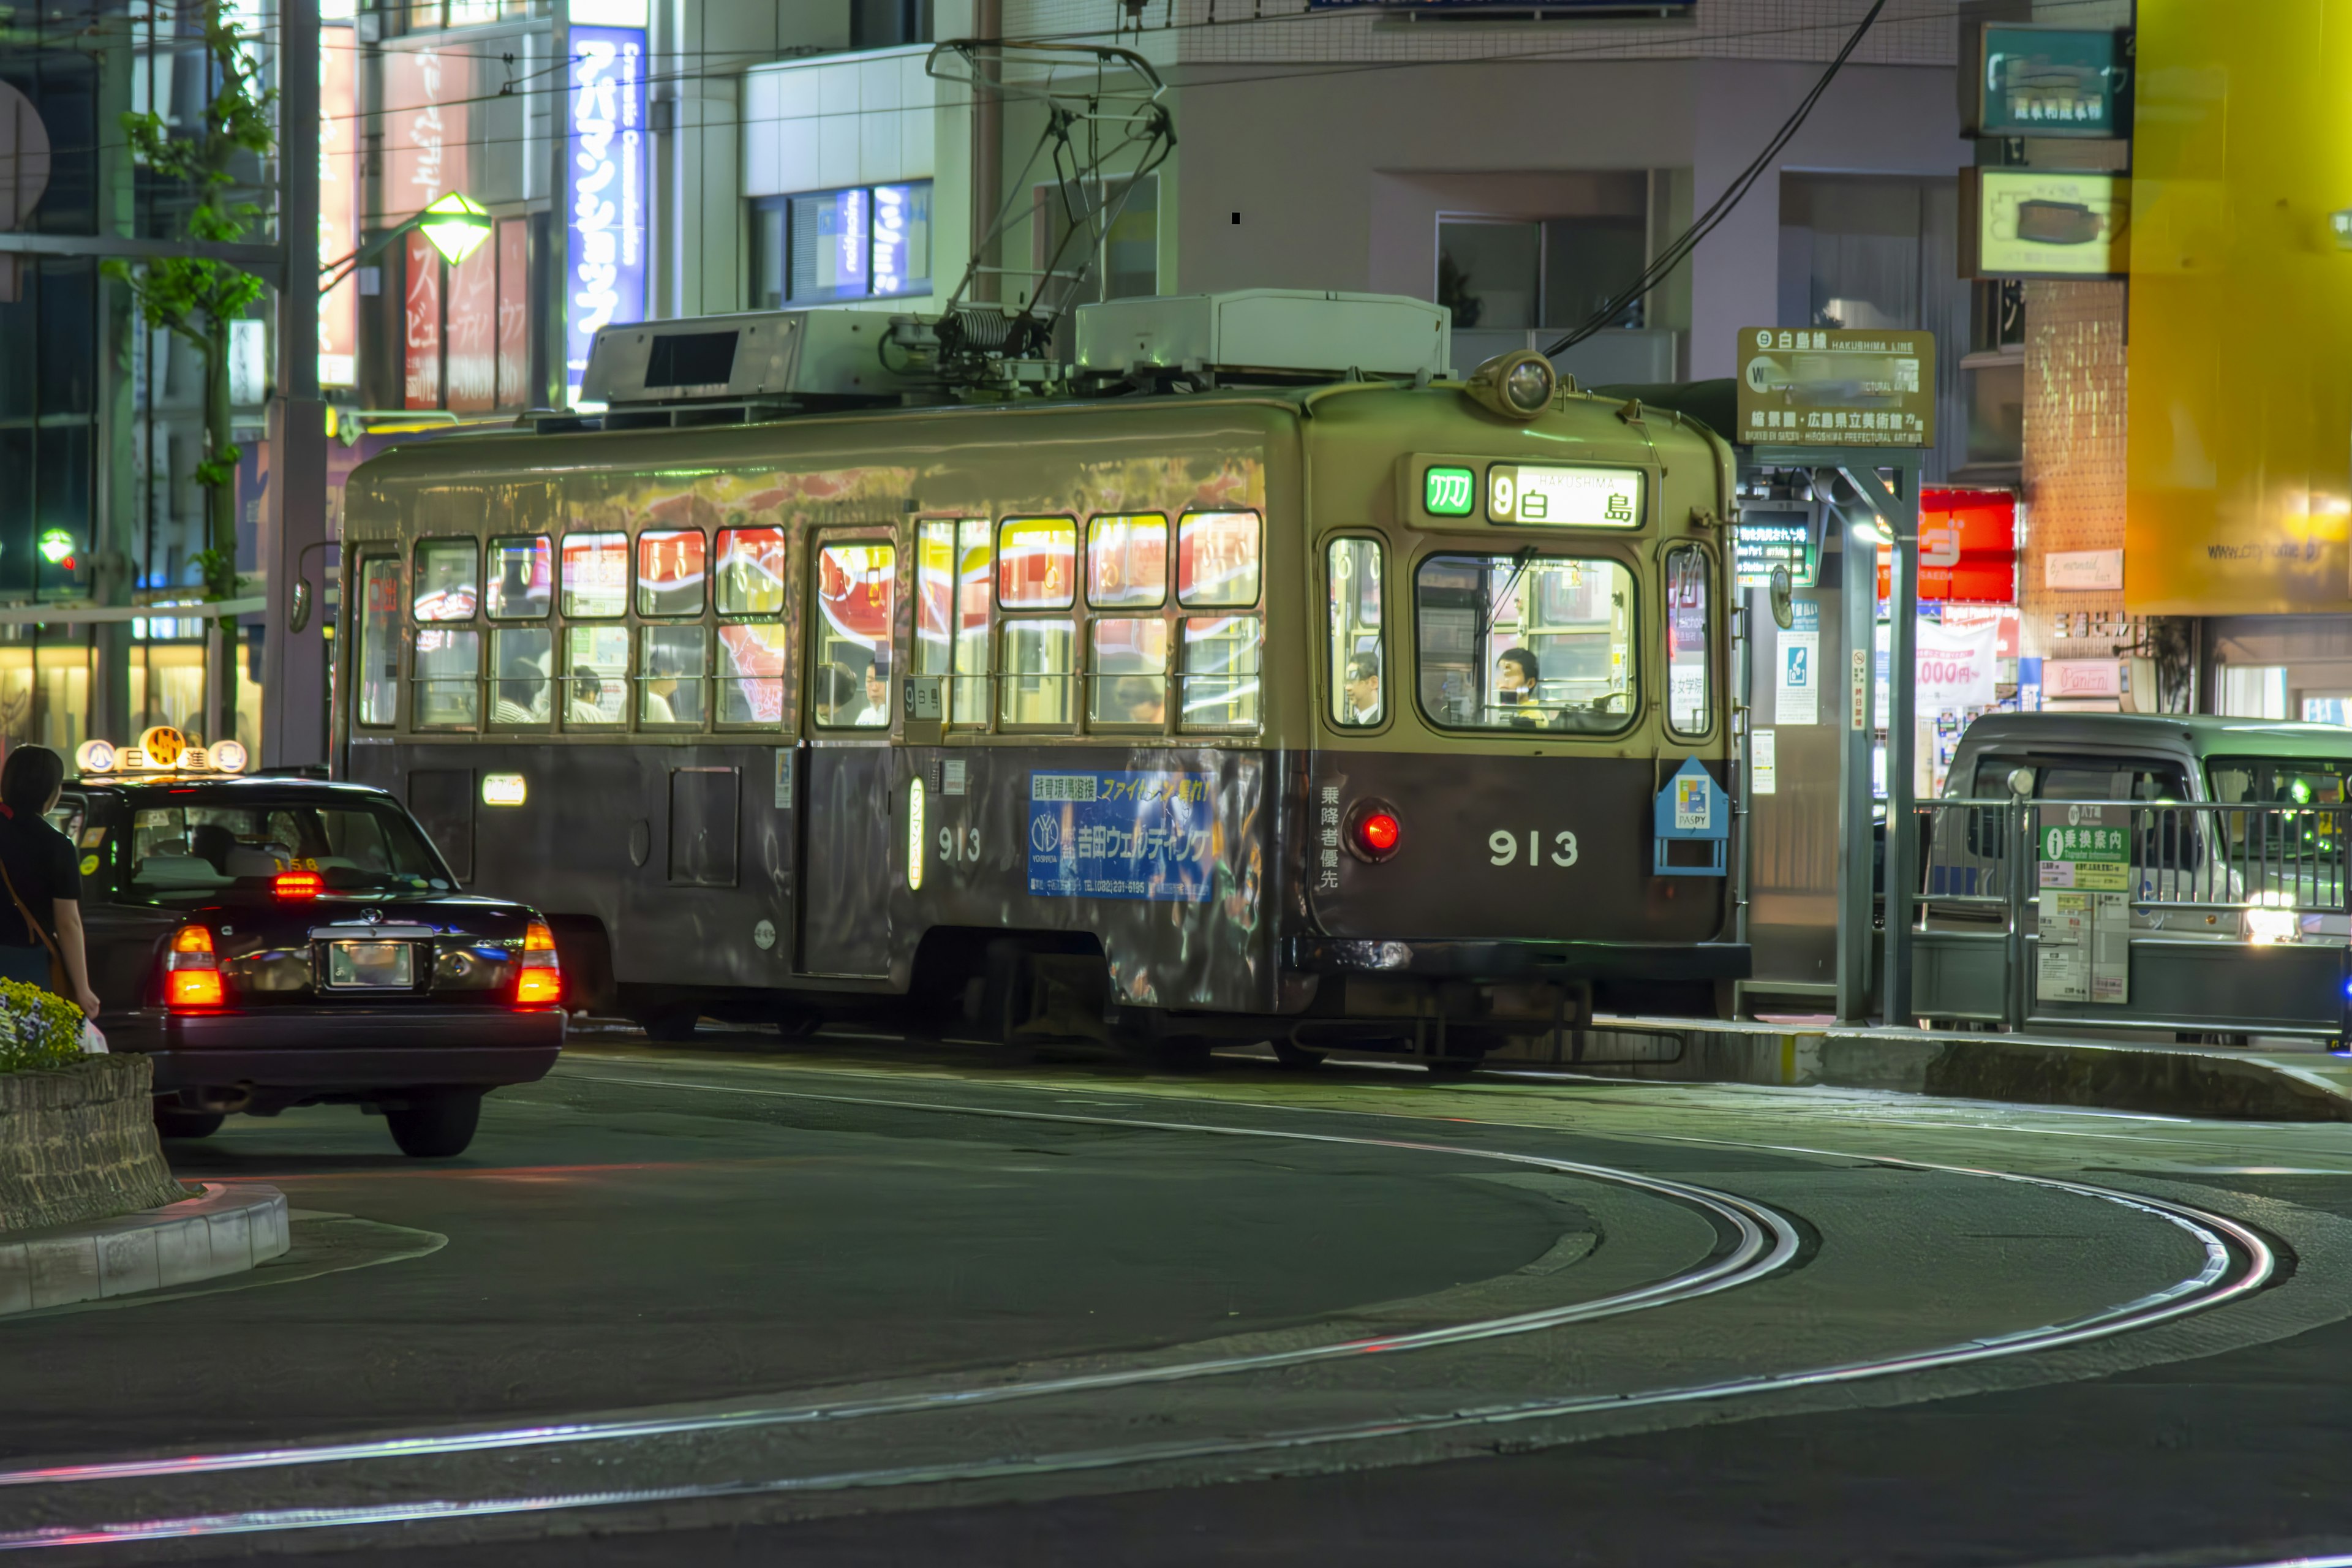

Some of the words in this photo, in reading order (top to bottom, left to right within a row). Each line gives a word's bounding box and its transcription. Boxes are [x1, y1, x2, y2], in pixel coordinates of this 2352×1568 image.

[1779, 331, 1827, 350] 白島線
[1832, 341, 1887, 351] HAKUSHIMA
[1891, 341, 1913, 352] LINE
[1805, 432, 1842, 442] HIROSHIMA
[1844, 432, 1891, 442] PREFECTURAL
[1539, 475, 1615, 490] HAKUSHIMA
[1494, 477, 1513, 515] 9
[905, 686, 914, 712] 9
[1679, 815, 1706, 826] PASPY
[939, 826, 980, 862] 913
[1321, 786, 1340, 888] 乗降者優先
[2065, 829, 2122, 850] 乗換案内
[1488, 829, 1578, 867] 913
